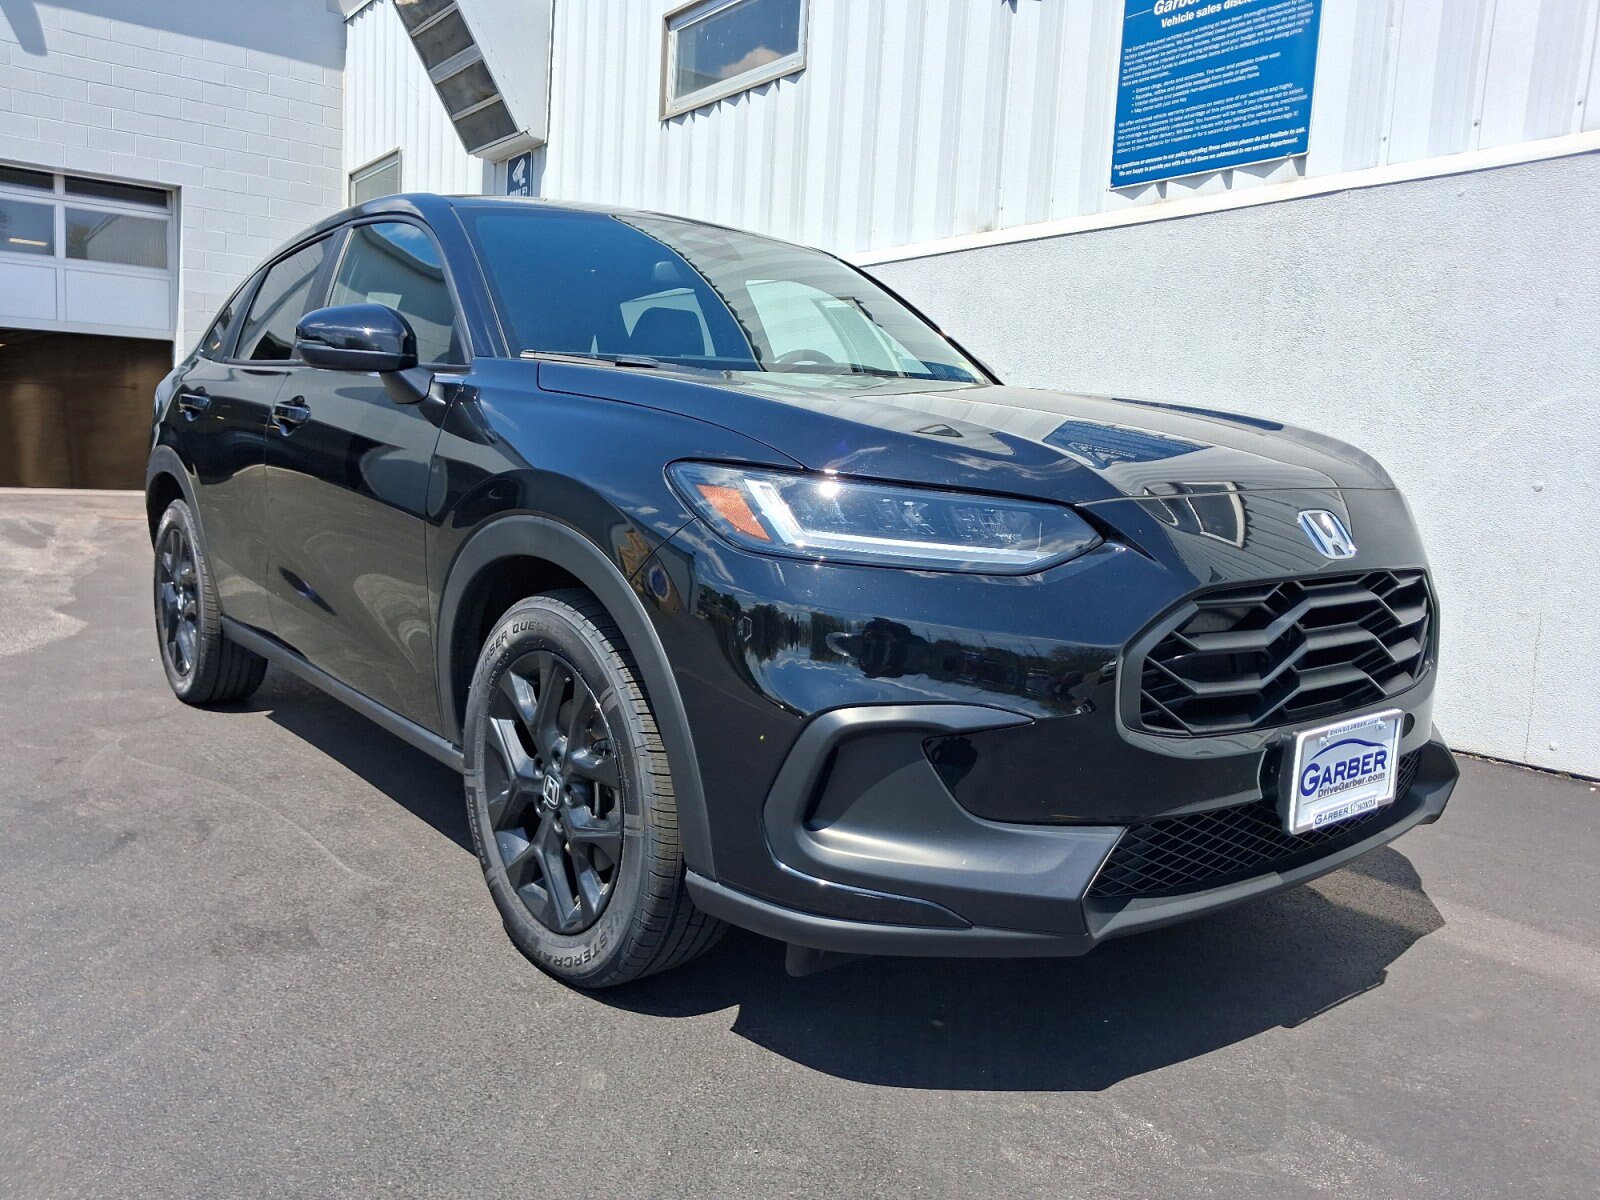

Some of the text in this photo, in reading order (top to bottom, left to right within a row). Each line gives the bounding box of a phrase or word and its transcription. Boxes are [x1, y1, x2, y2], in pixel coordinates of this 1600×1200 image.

[1153, 0, 1200, 15] Garbe
[1161, 11, 1195, 28] Vehicle
[1196, 3, 1222, 18] sales
[1300, 750, 1387, 796] GARBER
[1318, 771, 1385, 798] DriveGarber.com
[1314, 807, 1349, 825] GARBER
